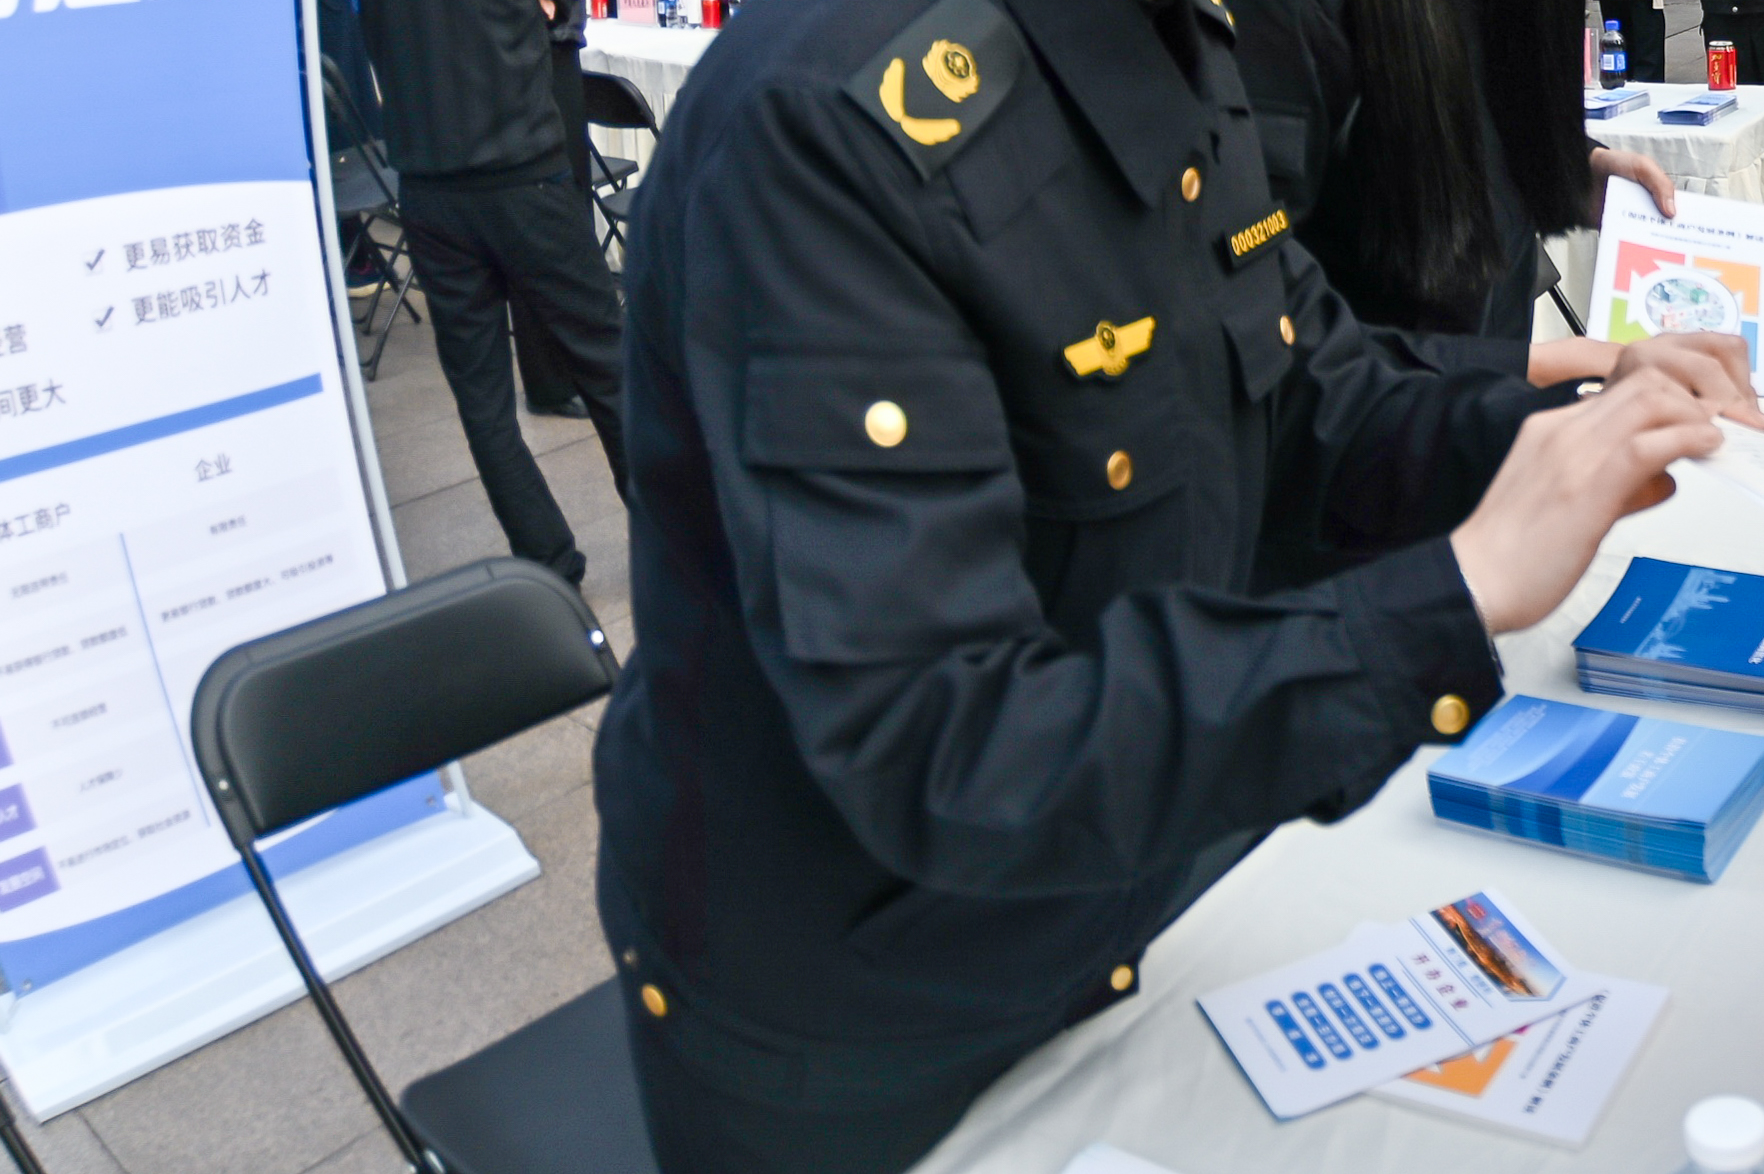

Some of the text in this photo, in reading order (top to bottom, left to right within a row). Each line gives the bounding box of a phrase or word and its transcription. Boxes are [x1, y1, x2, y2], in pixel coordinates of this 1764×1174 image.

[123, 217, 266, 272] 更易获取资金
[132, 268, 272, 326] 更能吸引人才
[194, 452, 233, 483] 企业
